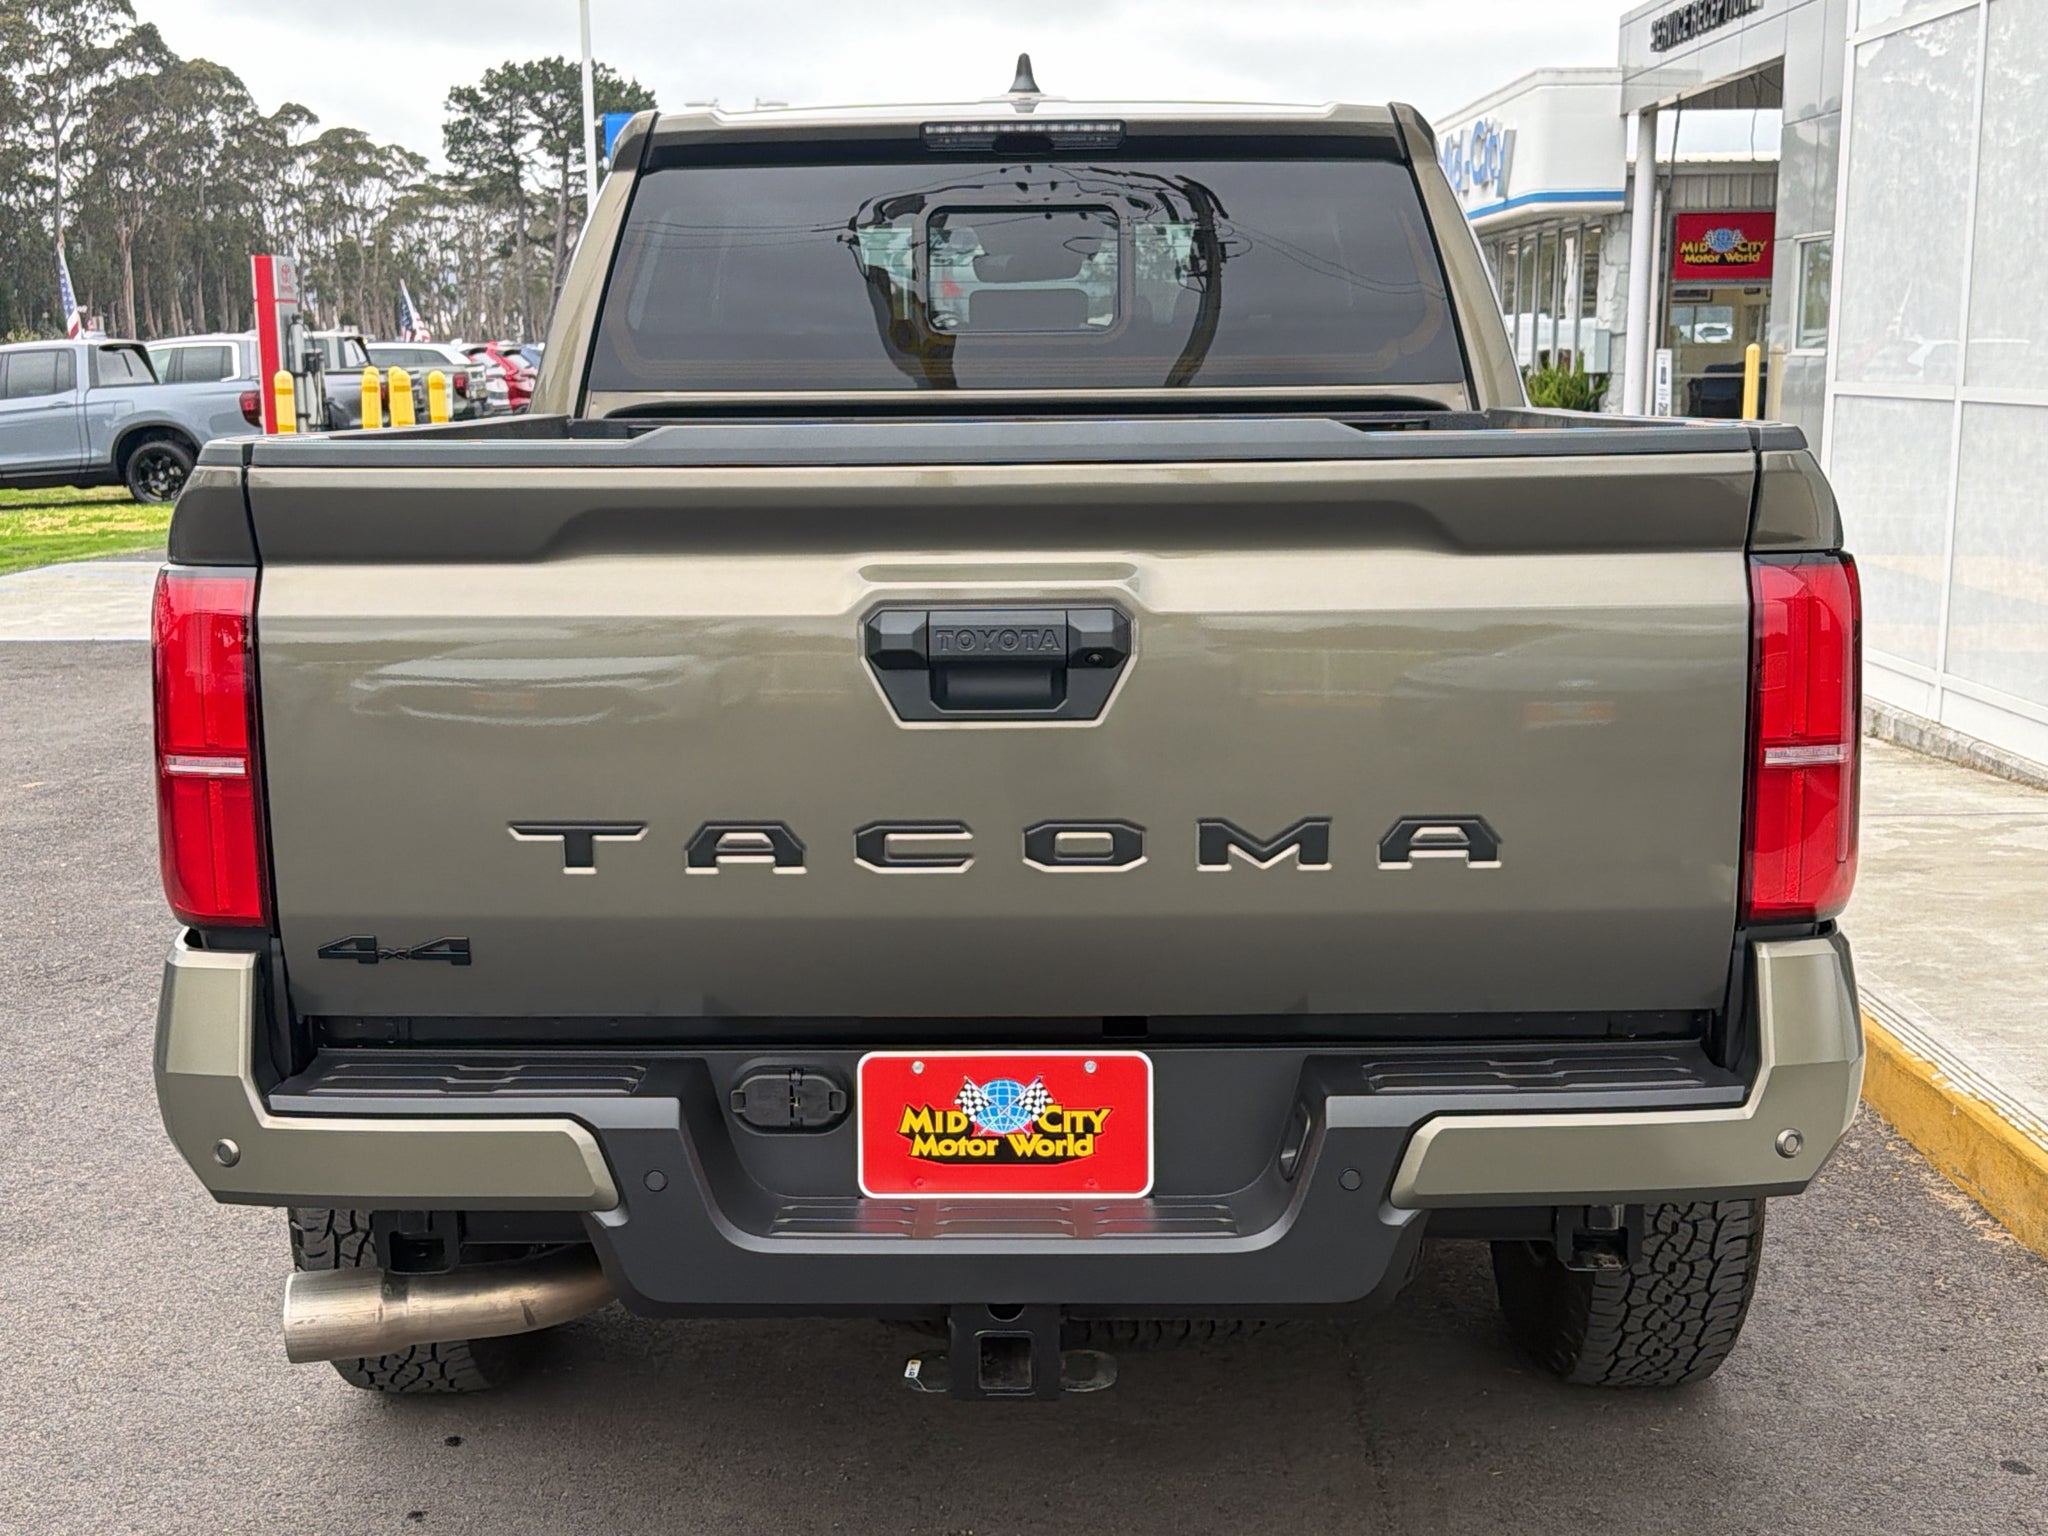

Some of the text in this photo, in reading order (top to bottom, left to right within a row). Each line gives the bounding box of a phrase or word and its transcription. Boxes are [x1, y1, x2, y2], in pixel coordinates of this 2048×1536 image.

[1650, 4, 1690, 51] SERVICE
[1680, 240, 1709, 254] MID
[1683, 251, 1761, 264] Motor World
[935, 628, 1061, 652] TOYOTA
[507, 816, 1503, 876] TACOMA
[899, 1103, 1113, 1135] MID CITY
[910, 1132, 1094, 1158] Motor World
